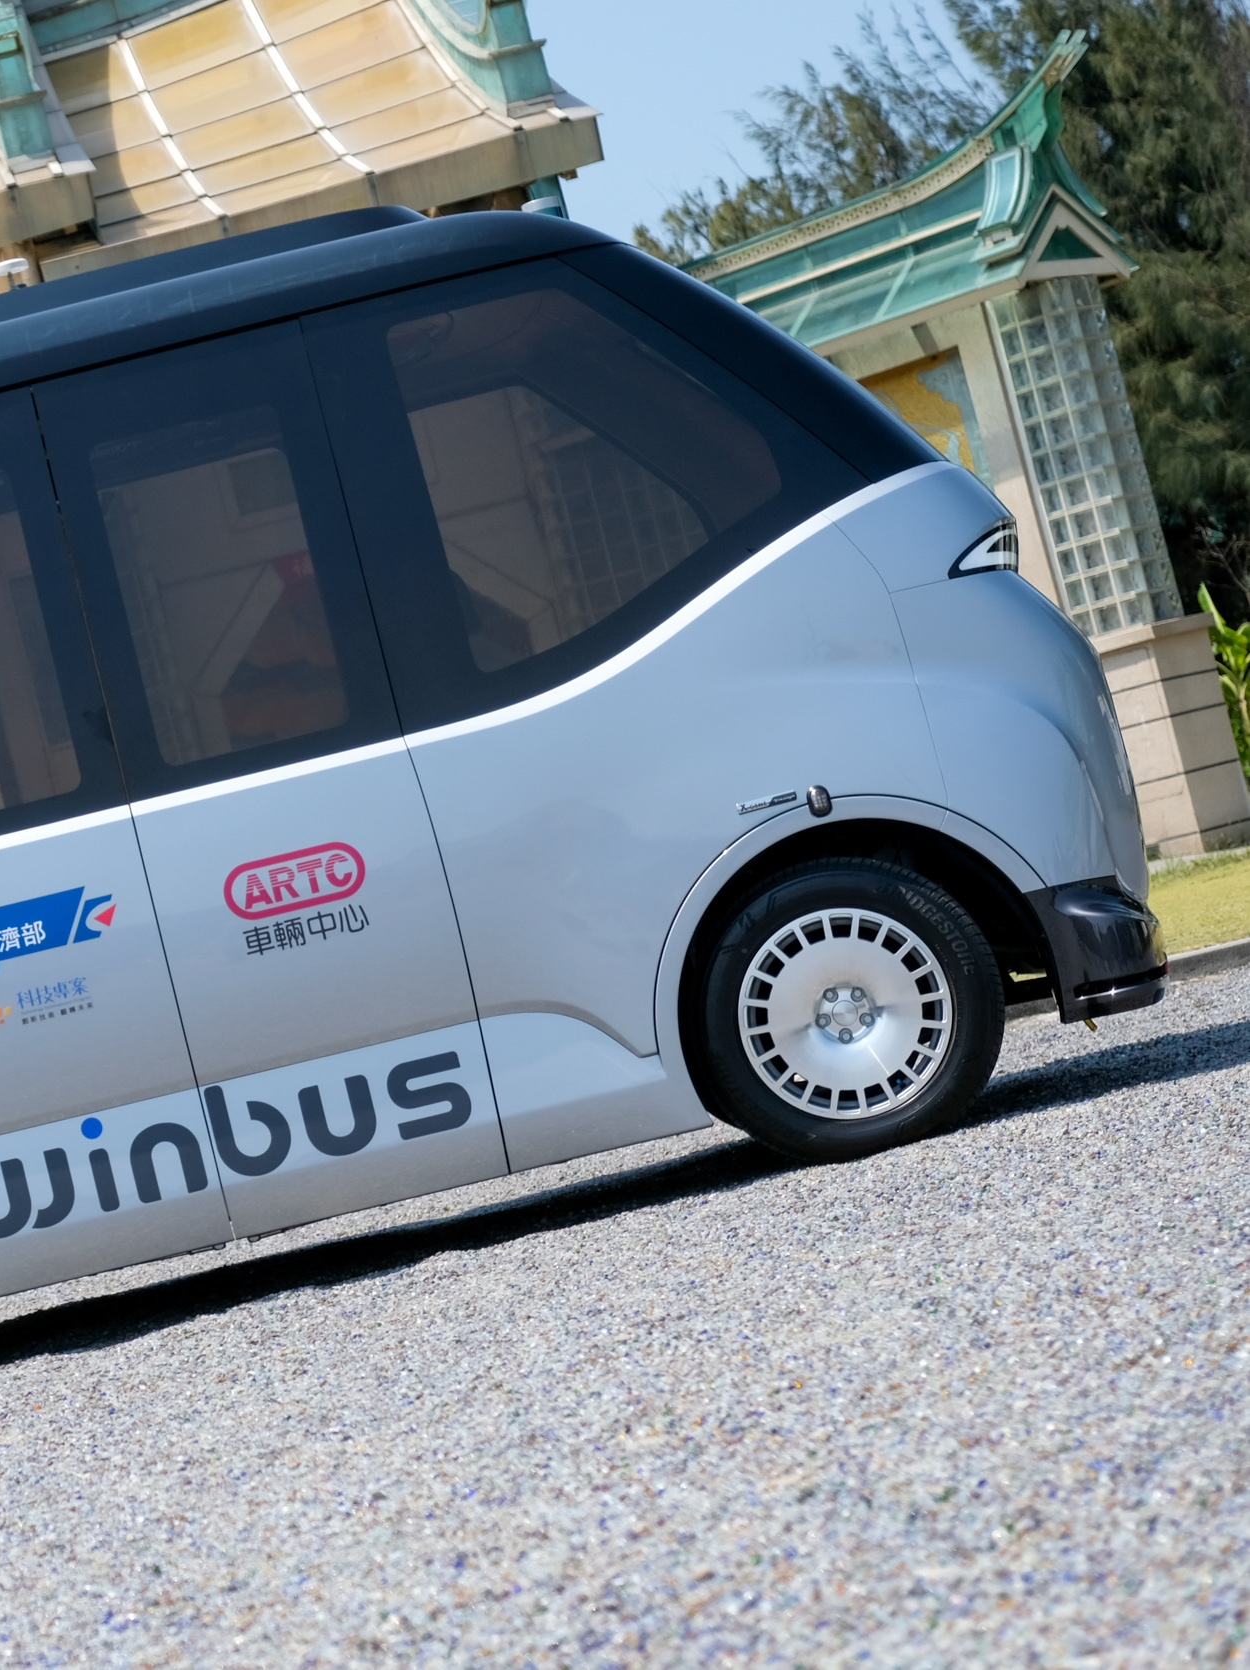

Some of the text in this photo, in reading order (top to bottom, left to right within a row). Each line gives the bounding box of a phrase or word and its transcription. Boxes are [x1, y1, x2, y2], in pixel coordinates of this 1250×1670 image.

[244, 853, 353, 910] ARTC
[242, 904, 370, 956] 車輛中心
[15, 977, 89, 1010] 科技專案
